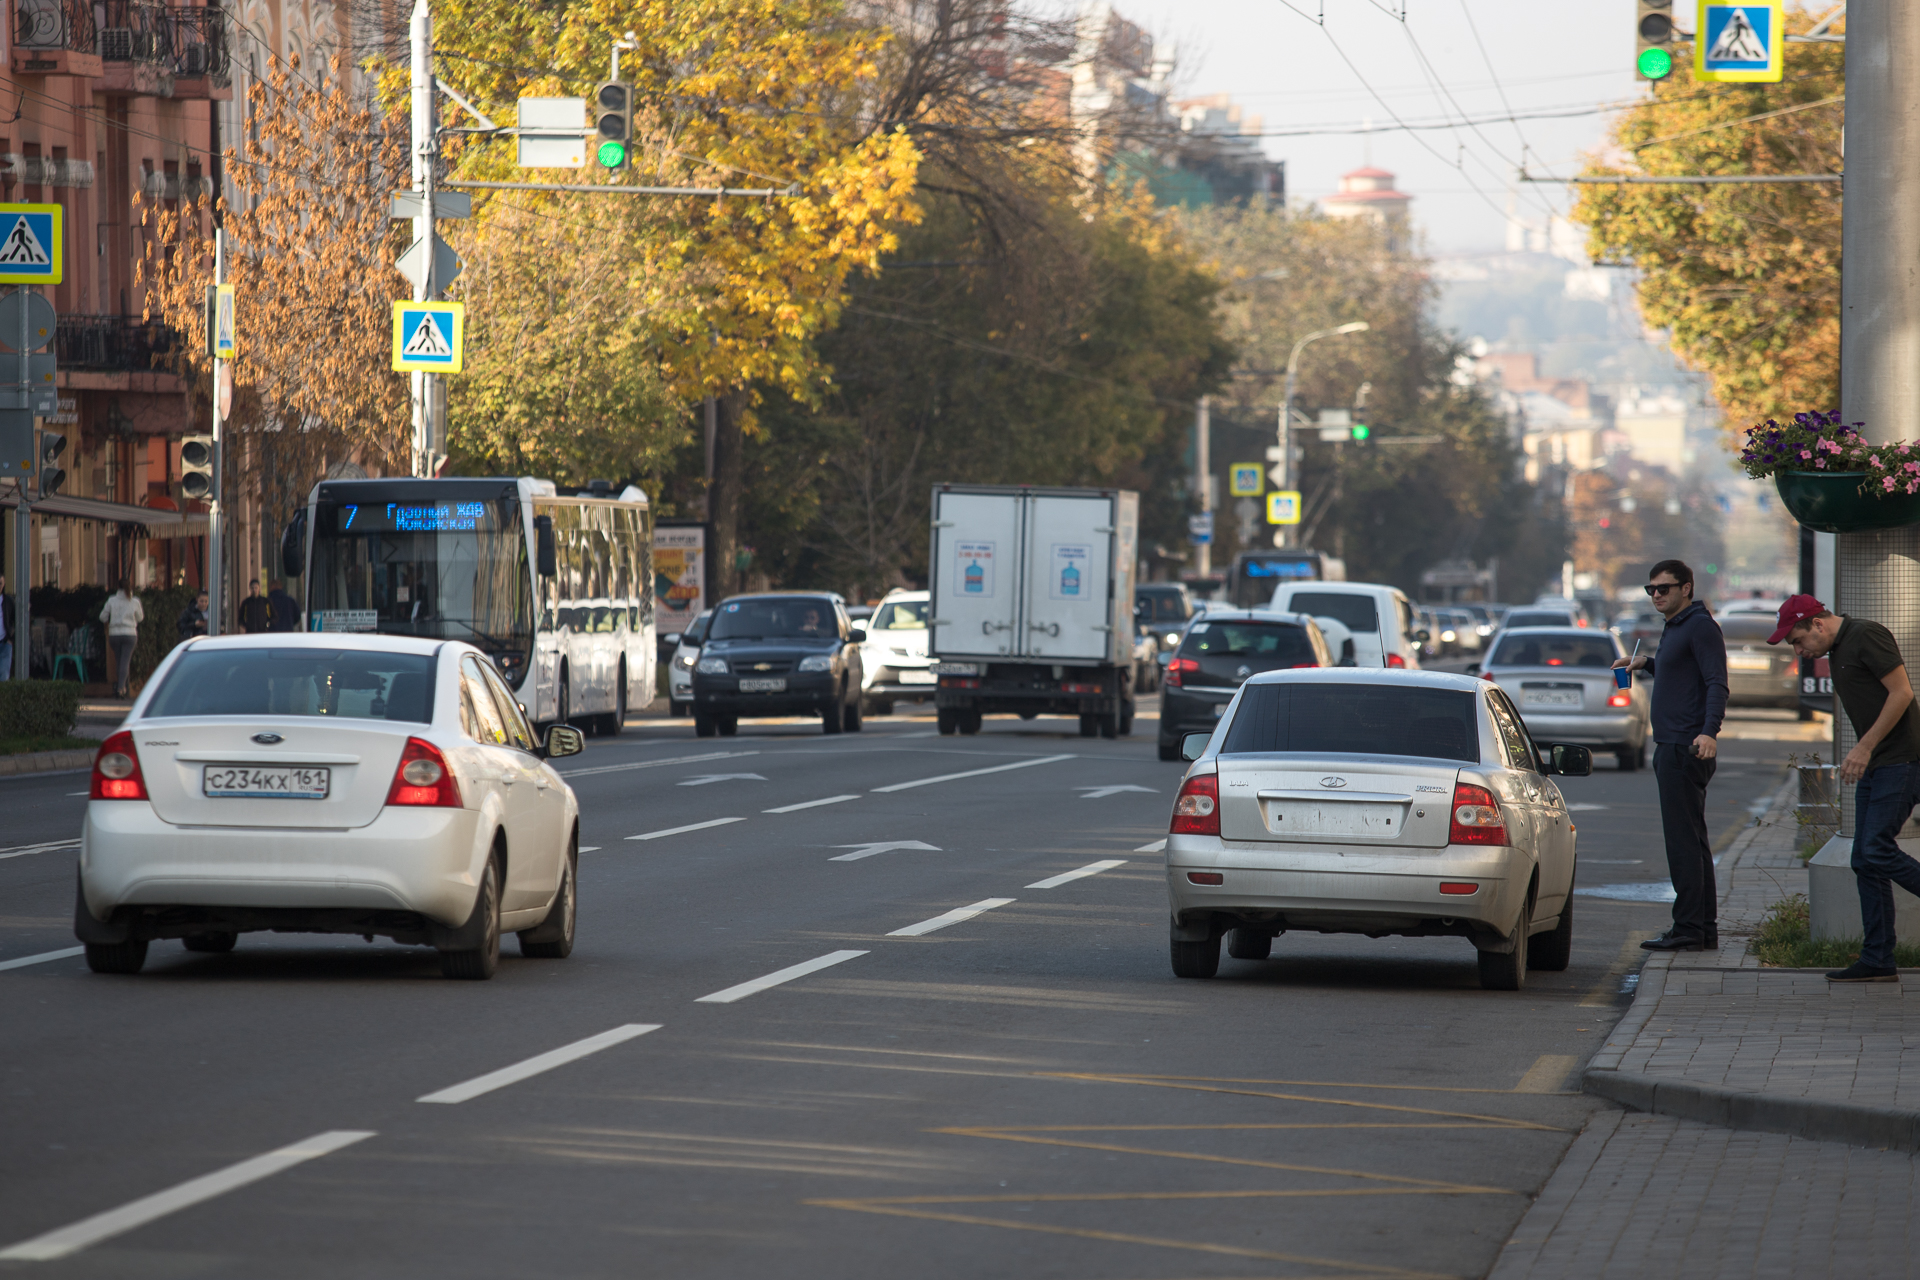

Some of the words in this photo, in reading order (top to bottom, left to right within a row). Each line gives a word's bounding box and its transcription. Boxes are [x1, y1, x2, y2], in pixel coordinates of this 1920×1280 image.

[345, 504, 358, 529] 7
[387, 503, 449, 518] Главный
[456, 502, 484, 517] ЖДВ
[396, 515, 475, 530] Можайская
[312, 614, 321, 632] 7
[1803, 677, 1816, 693] 8
[293, 770, 322, 785] 161
[1415, 785, 1448, 794] PRIORA
